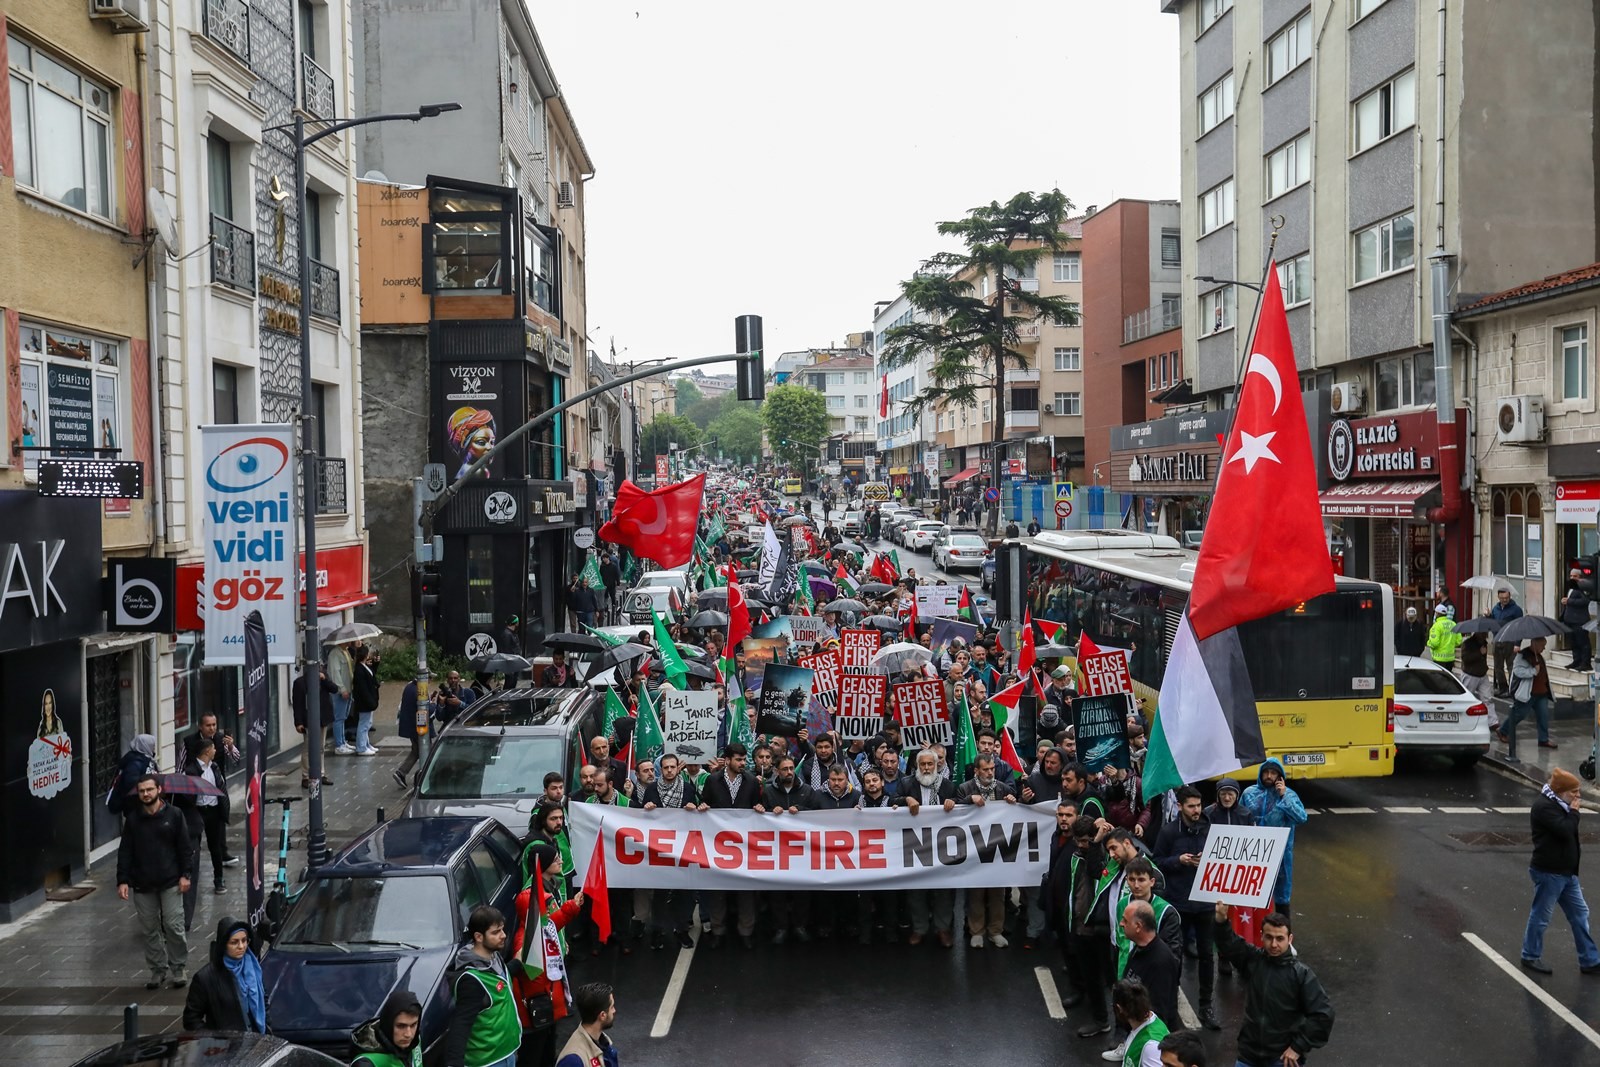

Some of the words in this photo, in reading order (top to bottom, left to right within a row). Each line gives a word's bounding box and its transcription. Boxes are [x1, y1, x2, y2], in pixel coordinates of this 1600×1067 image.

[450, 366, 495, 377] VİZYON
[1179, 420, 1192, 433] pierre
[1192, 417, 1207, 429] cardin
[1356, 419, 1397, 445] ELAZIĞ
[1142, 454, 1174, 481] SANAT
[1177, 452, 1206, 481] HALI
[1357, 447, 1415, 472] KÖFTECİSİ
[207, 492, 288, 524] veni
[213, 530, 283, 562] vidi
[213, 570, 284, 611] göz
[222, 635, 245, 645] 444
[844, 633, 877, 647] CEASE
[801, 653, 838, 672] CEASE
[843, 647, 877, 666] FIRE
[1085, 654, 1125, 675] CEASE
[842, 677, 882, 694] CEASE
[897, 683, 941, 703] CEASE
[1088, 669, 1130, 697] FIRE
[840, 694, 881, 717] FIRE
[901, 699, 944, 726] FIRE
[839, 717, 880, 738] NOW!
[903, 722, 948, 748] NOW!
[1287, 755, 1295, 763] 34
[32, 771, 60, 790] HEDİYE
[614, 826, 887, 871] CEASEFIRE
[903, 821, 1039, 868] NOW!
[1209, 836, 1275, 863] ABLUKAYI
[1199, 862, 1268, 897] KALDIR!
